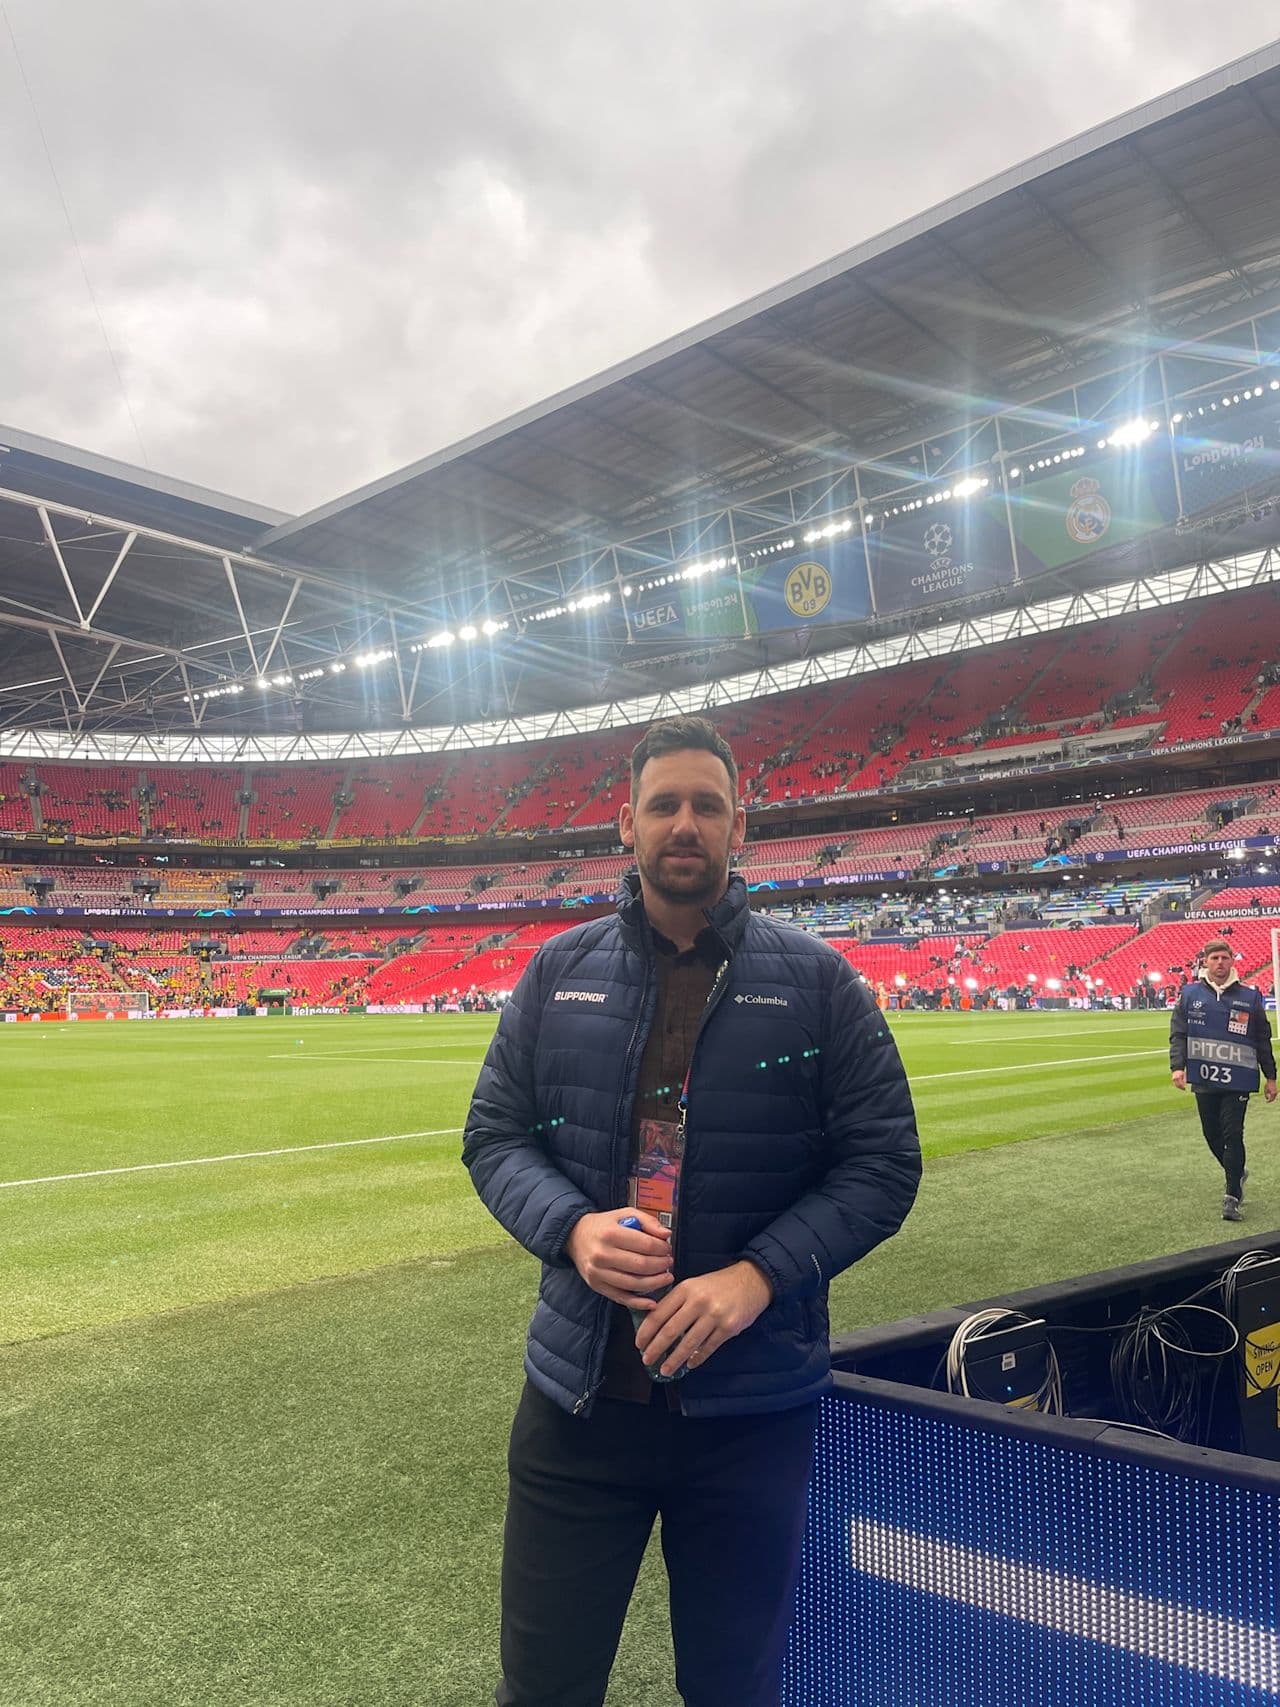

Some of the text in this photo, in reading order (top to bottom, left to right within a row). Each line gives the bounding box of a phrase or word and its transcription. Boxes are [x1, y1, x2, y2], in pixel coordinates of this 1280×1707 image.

[913, 563, 973, 587] CHAMPIONS
[791, 568, 827, 604] BVB
[923, 576, 964, 594] LEAGUE
[803, 598, 817, 611] 09
[634, 605, 678, 629] UEFA
[1151, 735, 1243, 756] UEFA CHAMPIONS LEAGUE
[1127, 839, 1247, 859] UEFA CHAMPIONS LEAGUE
[860, 873, 885, 882] FINAL
[1184, 906, 1280, 919] UEFA CHAMPIONS LEA
[934, 925, 957, 934] FINAL
[554, 991, 606, 1003] SUPPONOR
[744, 994, 788, 1007] Columbia
[1191, 1040, 1242, 1062] PITCH
[1200, 1063, 1232, 1083] 023
[1256, 1360, 1273, 1376] OPEN
